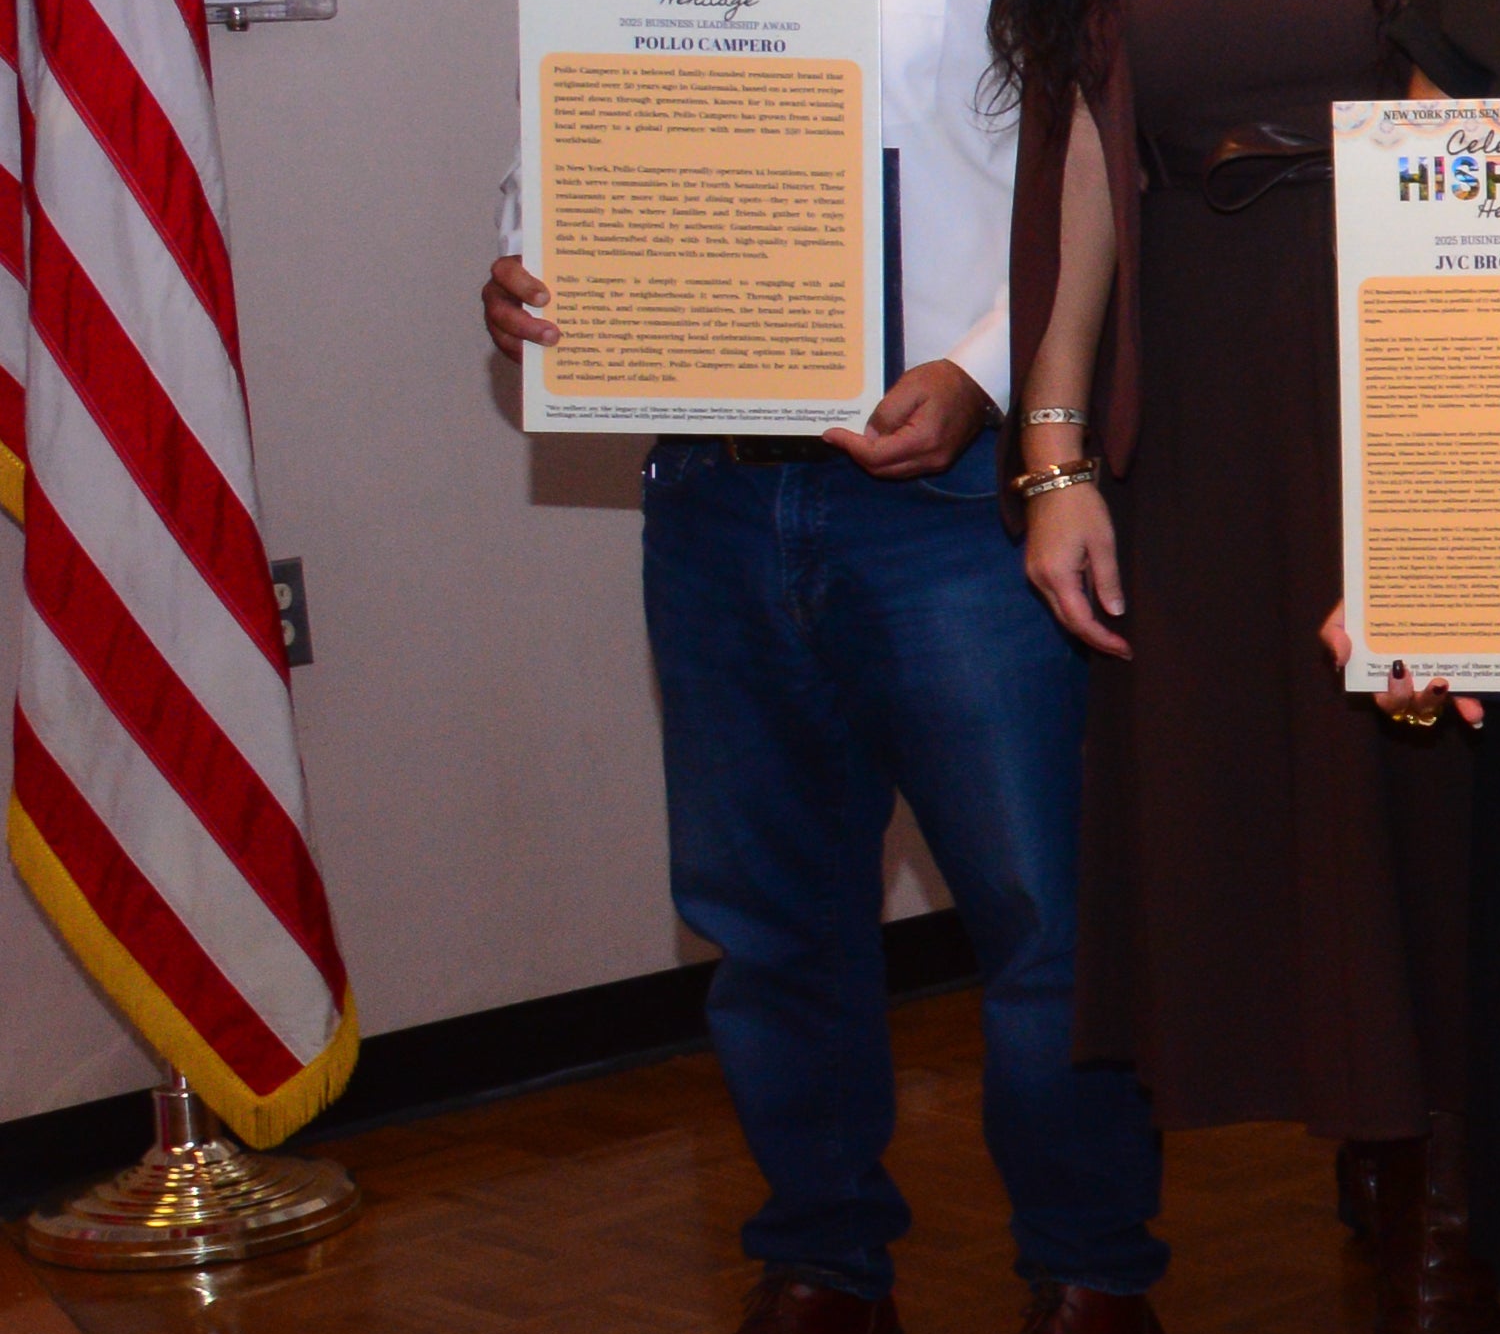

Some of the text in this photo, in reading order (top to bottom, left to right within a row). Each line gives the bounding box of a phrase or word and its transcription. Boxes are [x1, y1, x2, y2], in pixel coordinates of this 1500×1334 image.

[632, 36, 786, 52] POLLO CAMPERO
[1383, 110, 1409, 120] NEW
[1411, 109, 1442, 119] YORK
[1444, 109, 1477, 119] STATE
[1433, 255, 1470, 269] JVC
